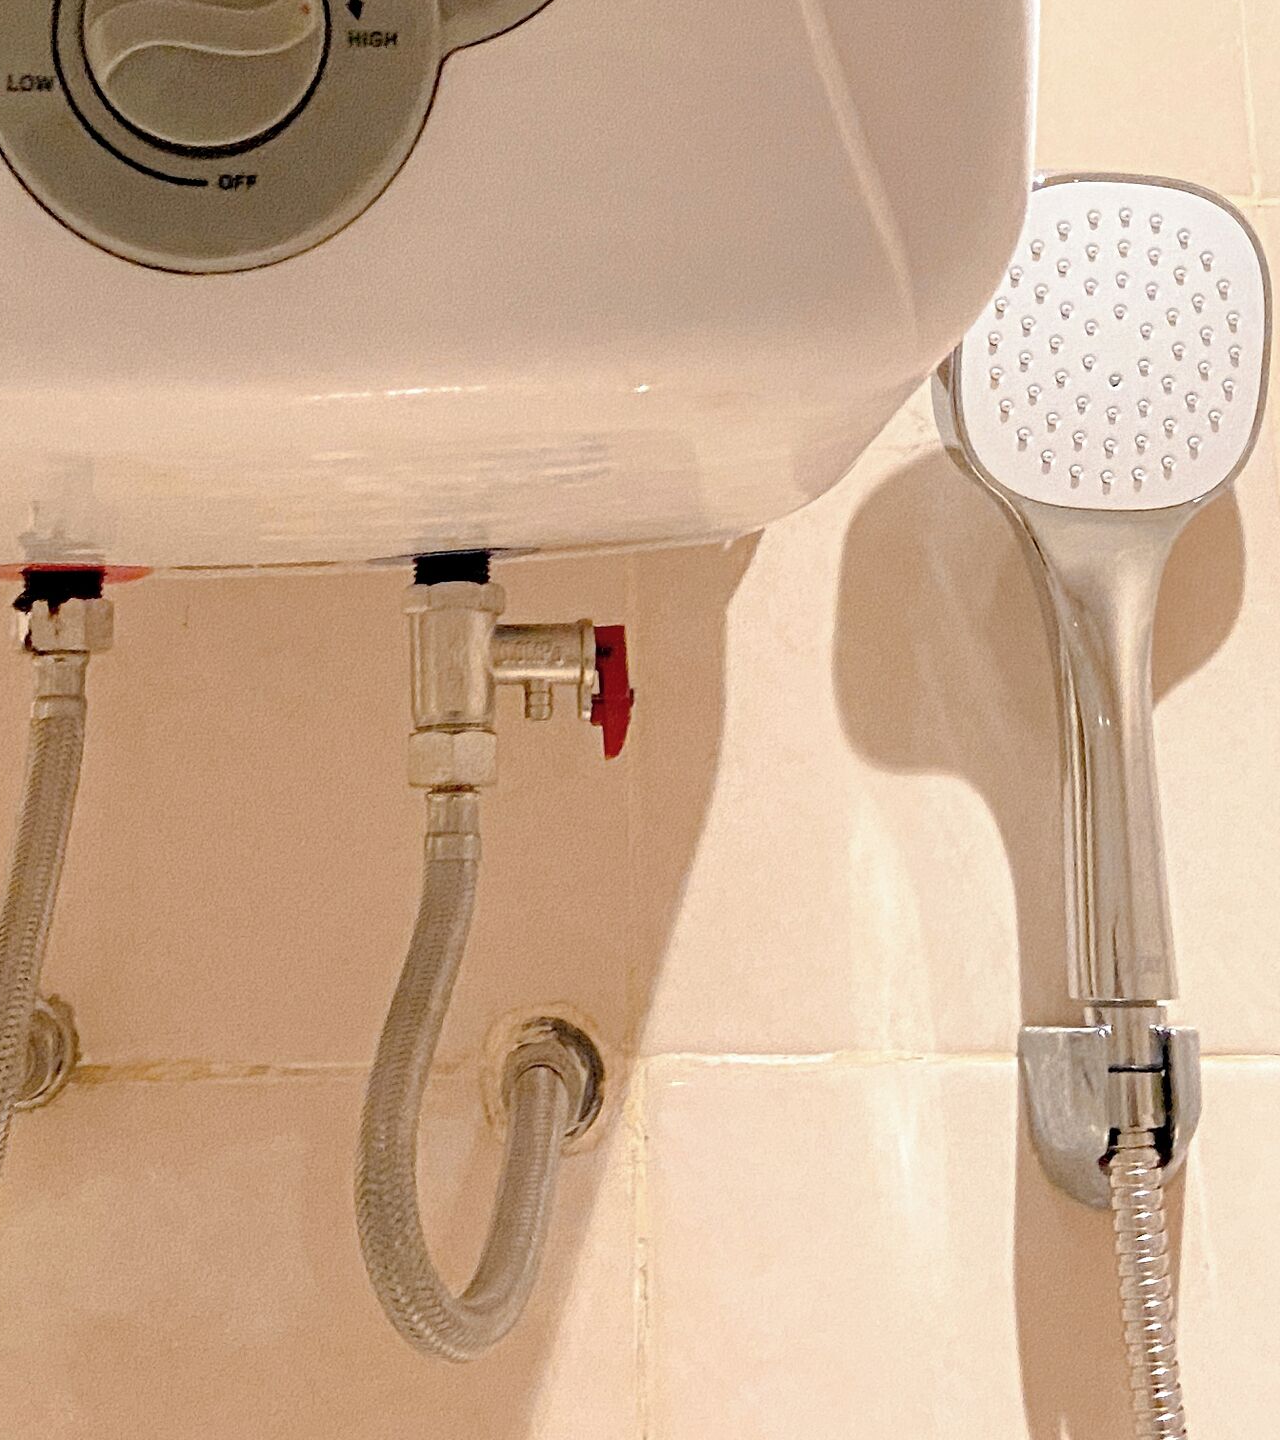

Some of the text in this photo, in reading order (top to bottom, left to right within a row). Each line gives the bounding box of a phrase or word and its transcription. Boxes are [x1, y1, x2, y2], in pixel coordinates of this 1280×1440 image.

[347, 29, 399, 48] HIGH
[6, 73, 55, 92] LOW
[219, 173, 258, 191] OFF
